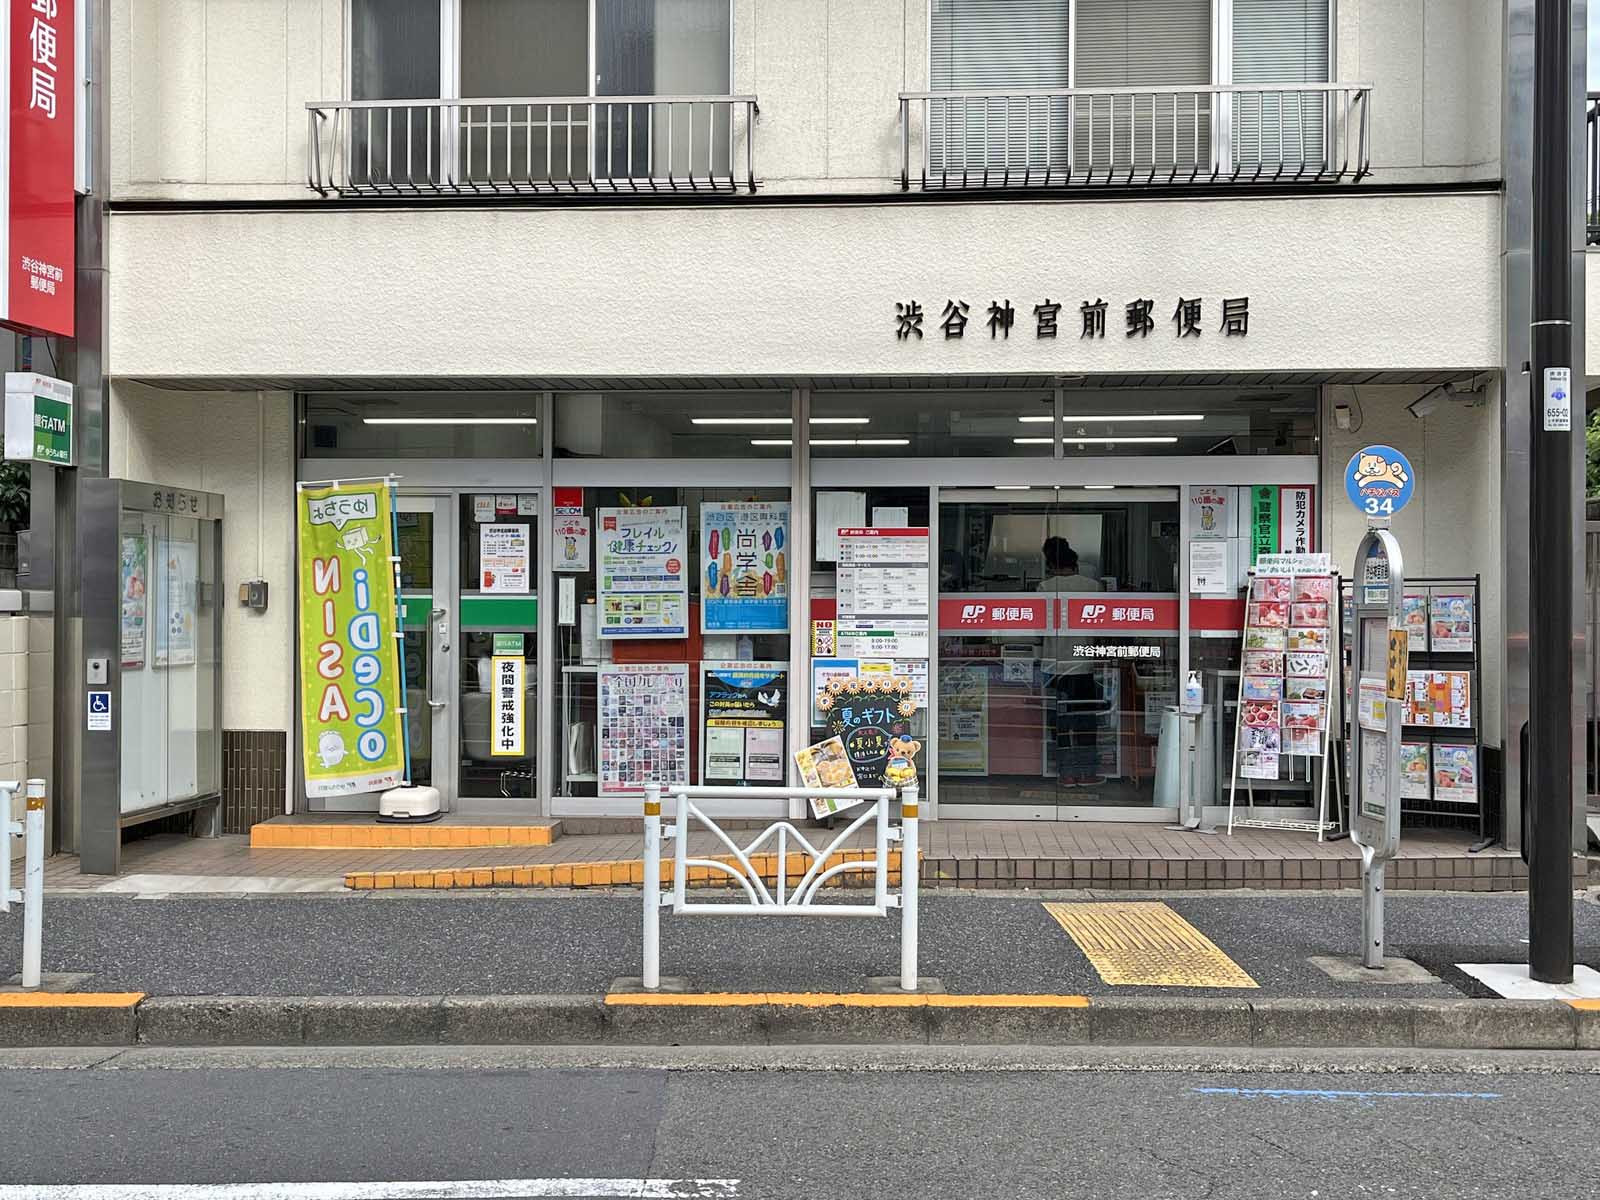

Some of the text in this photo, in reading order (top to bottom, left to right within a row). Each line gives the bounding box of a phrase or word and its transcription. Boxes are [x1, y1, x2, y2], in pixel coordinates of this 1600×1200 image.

[22, 255, 63, 282] 渋谷神宮前
[30, 275, 55, 296] 郵便局
[896, 297, 1250, 339] 渋谷神宮前郵便局
[153, 491, 198, 512] お知らせ
[555, 507, 581, 515] SECOM
[1365, 498, 1394, 514] 34
[1296, 491, 1306, 554] 防犯カメラ作動
[620, 527, 665, 539] フレイル
[992, 607, 1034, 621] 郵便局
[1112, 607, 1154, 621] 郵便局
[1072, 645, 1161, 658] 渋谷神宮前郵便局
[501, 662, 515, 750] 夜間警戒強化中
[841, 708, 895, 727] 夏のギフト
